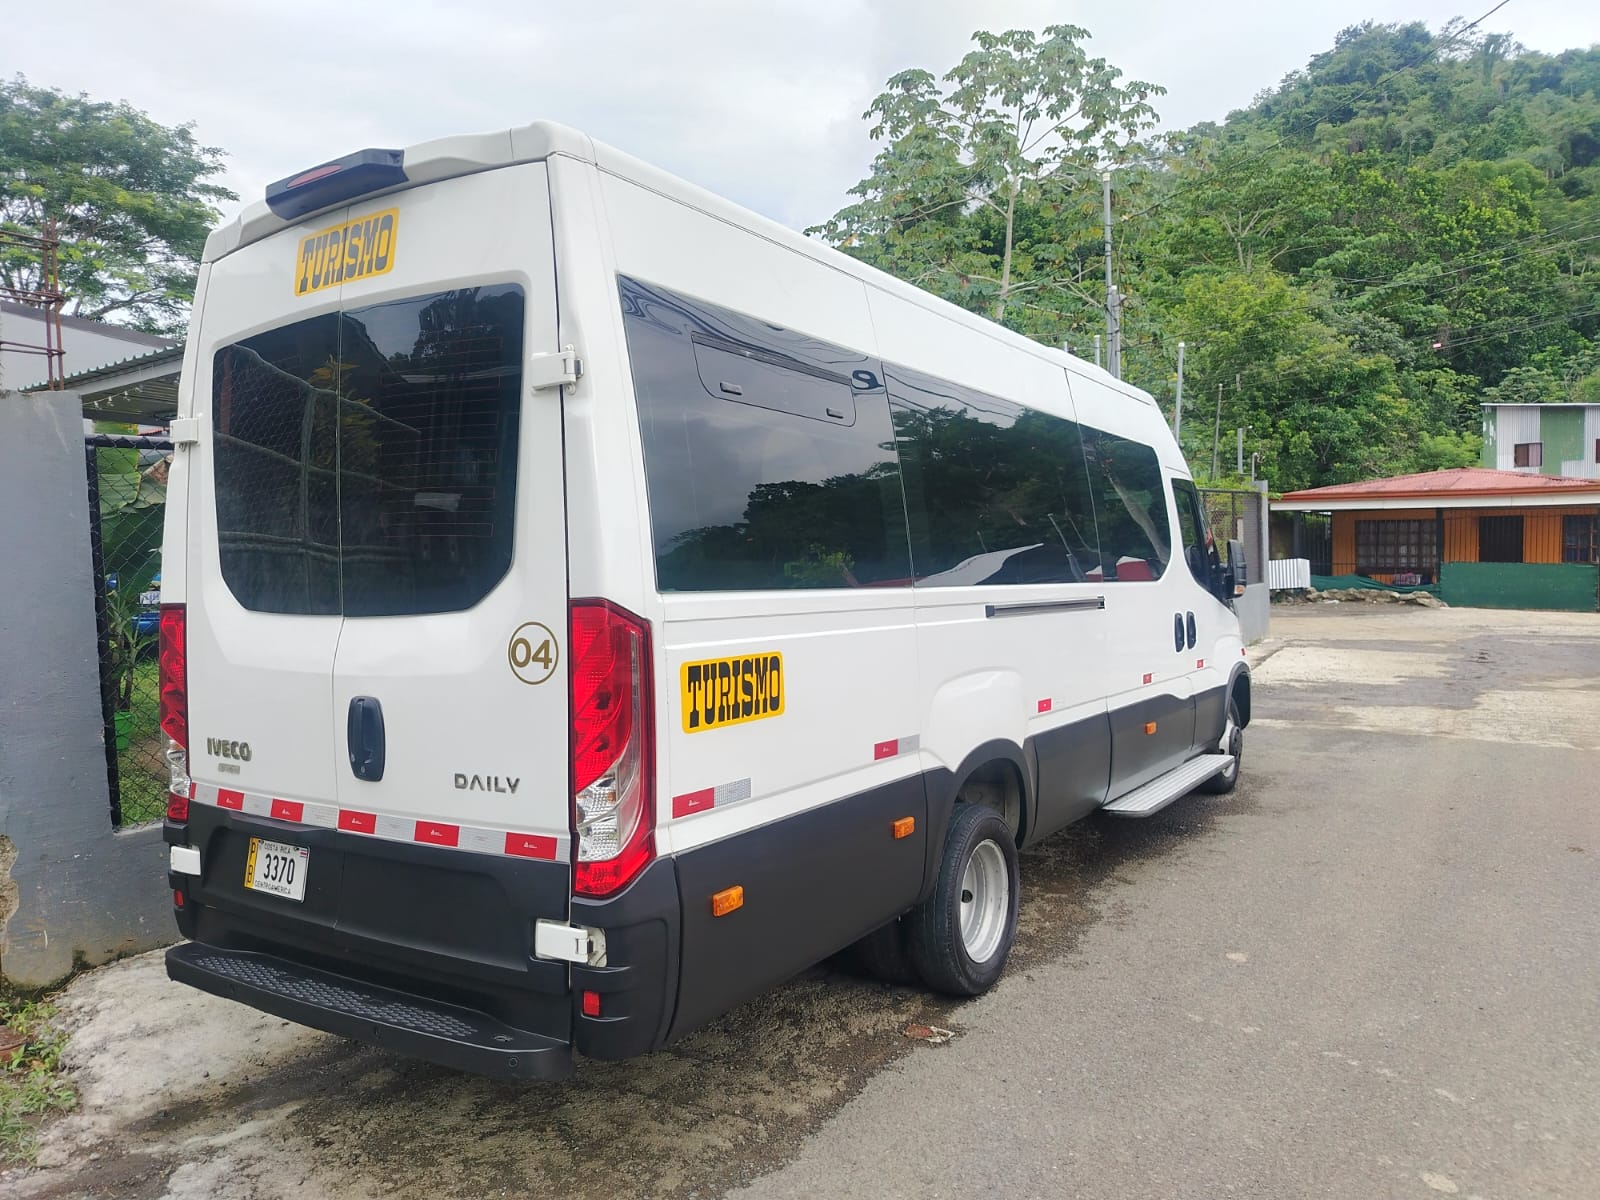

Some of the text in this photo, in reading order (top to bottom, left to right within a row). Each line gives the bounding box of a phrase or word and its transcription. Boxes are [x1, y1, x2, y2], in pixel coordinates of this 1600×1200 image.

[299, 214, 394, 293] TURISMO
[511, 637, 553, 670] 04
[687, 655, 781, 728] TURISMO
[207, 737, 252, 762] IVECO
[454, 773, 521, 794] DAILY
[247, 842, 257, 883] PB
[264, 842, 291, 854] COSTA RICA
[263, 853, 295, 885] 3370
